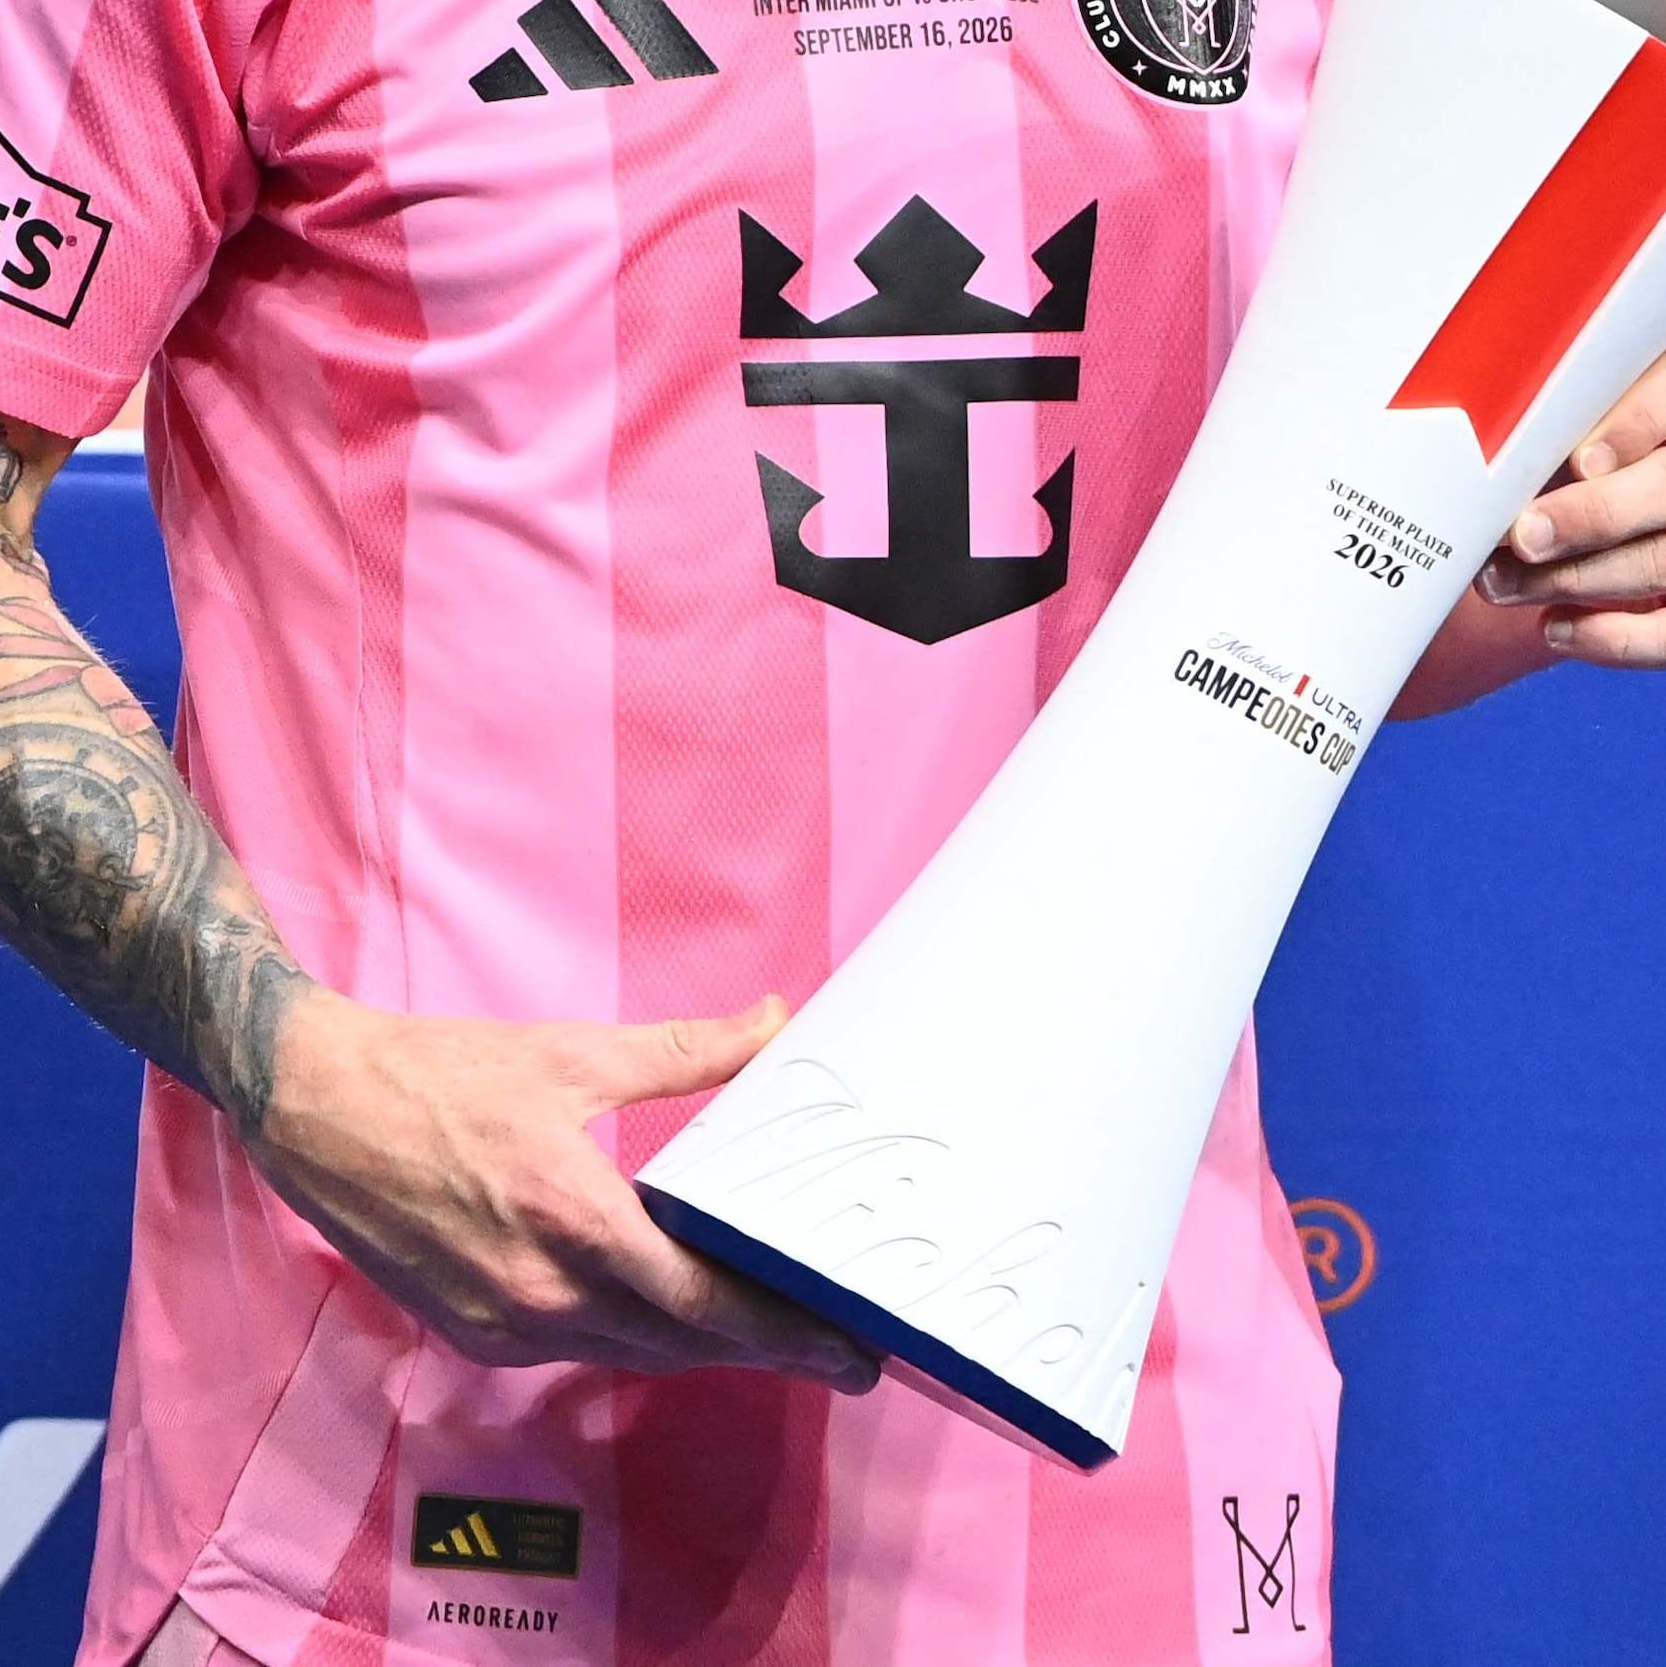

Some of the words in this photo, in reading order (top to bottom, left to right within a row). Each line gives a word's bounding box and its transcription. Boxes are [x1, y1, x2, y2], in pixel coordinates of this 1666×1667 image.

[793, 24, 913, 56] SEPTEMBER
[920, 20, 953, 49] 16,
[958, 16, 1013, 45] 2026
[1167, 75, 1236, 99] MMXX
[1326, 478, 1405, 531] SUPERIOR
[1405, 522, 1454, 560] PLAYER
[1332, 503, 1357, 526] OF
[1356, 515, 1389, 545] THE
[1388, 530, 1437, 572] MATCH
[1332, 533, 1409, 589] 2026
[1173, 648, 1326, 755] CAMPEONES
[1319, 732, 1357, 777] CUP
[1311, 686, 1364, 735] ULTRA
[427, 1600, 559, 1633] AEROREADY
